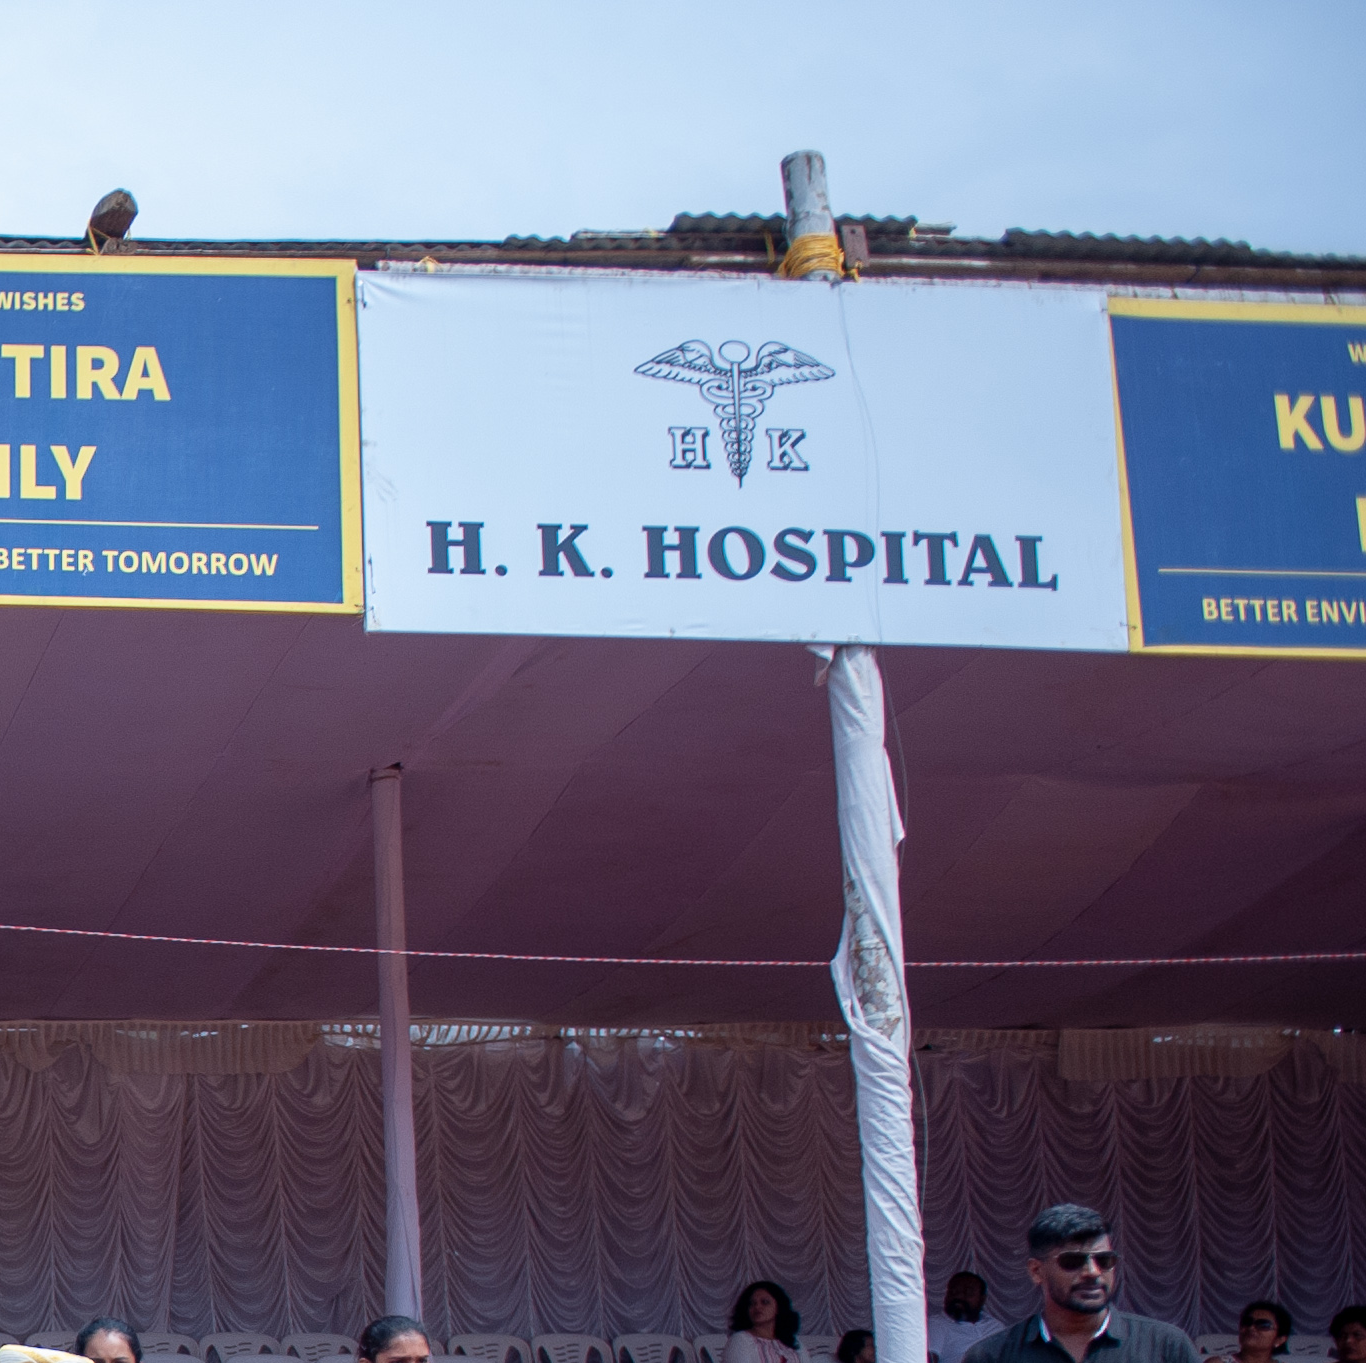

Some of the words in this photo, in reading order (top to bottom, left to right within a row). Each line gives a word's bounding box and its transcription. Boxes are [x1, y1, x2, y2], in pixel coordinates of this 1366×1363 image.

[667, 426, 712, 470] H
[766, 427, 810, 472] K
[102, 549, 279, 578] TOMORROW
[425, 519, 509, 577] H.
[536, 522, 614, 579] K.
[641, 525, 1059, 591] HOSPITAL
[1201, 597, 1299, 623] BETTER
